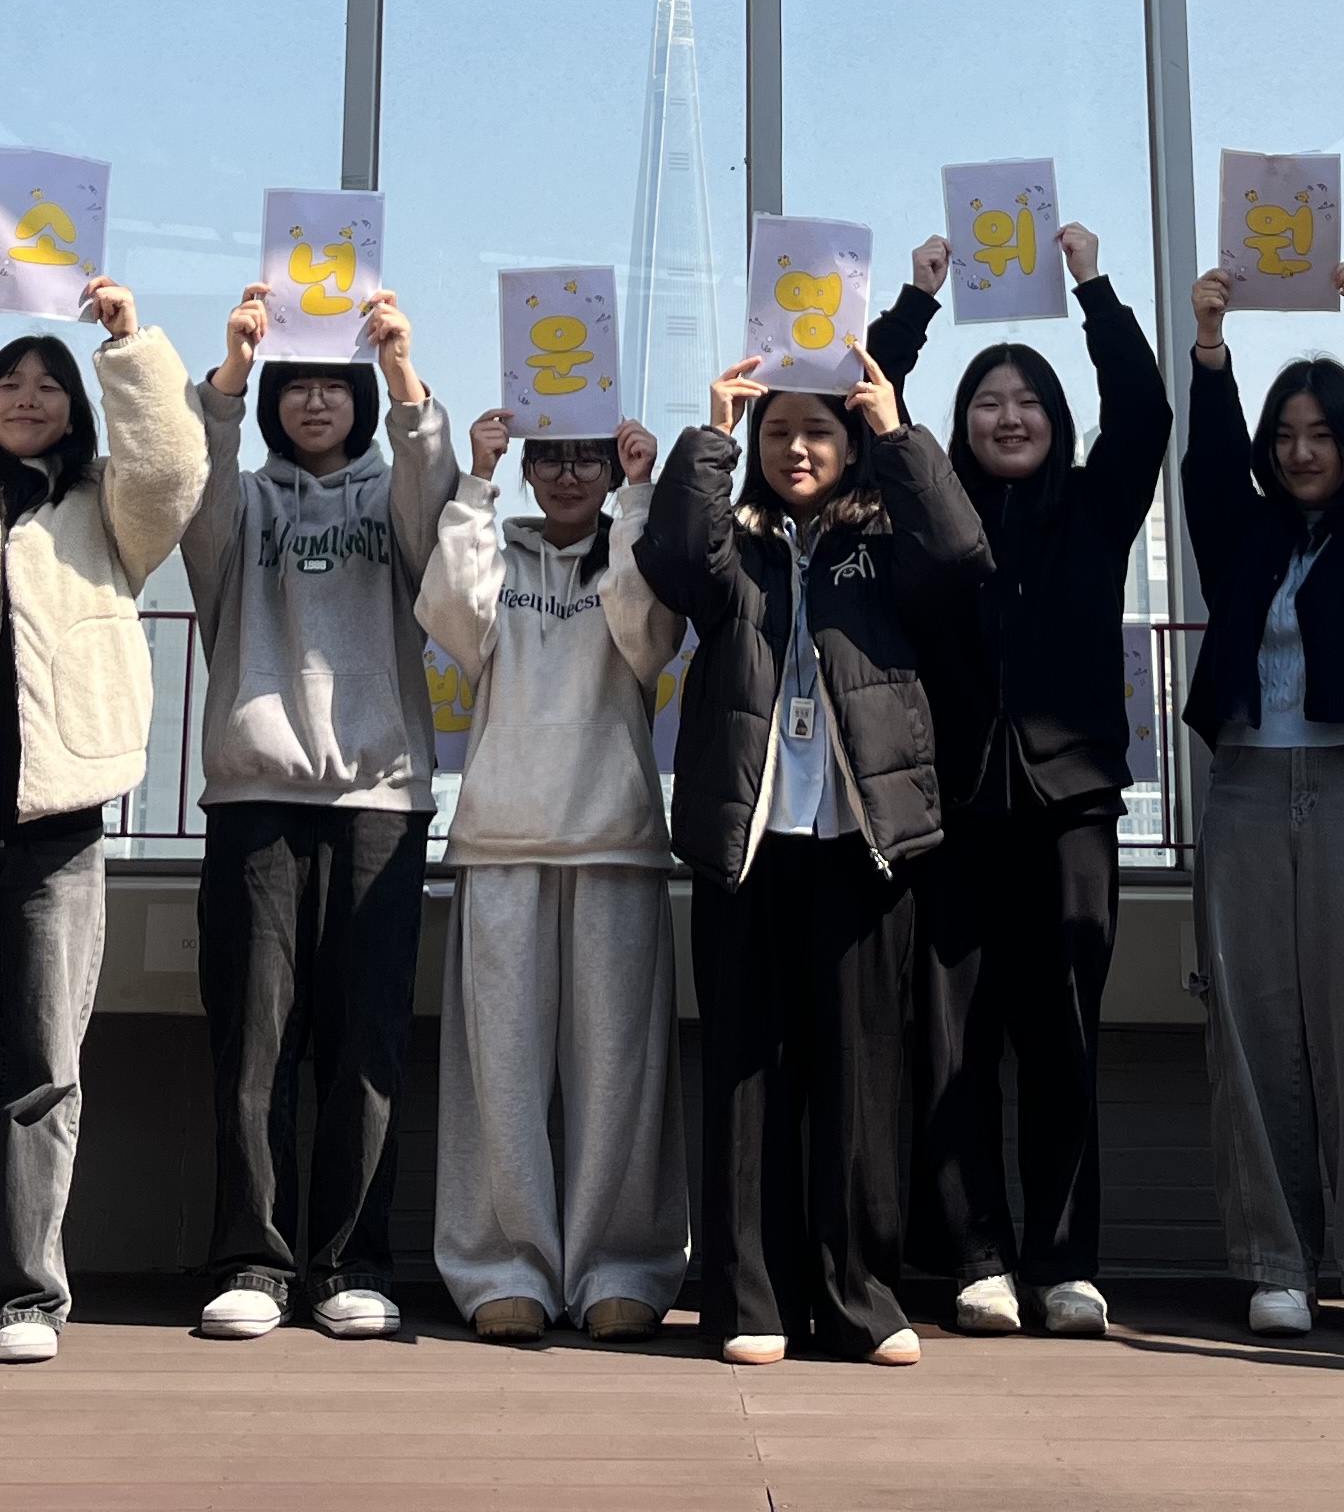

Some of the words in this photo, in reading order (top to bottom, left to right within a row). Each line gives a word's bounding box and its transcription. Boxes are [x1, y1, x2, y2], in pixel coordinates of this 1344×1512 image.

[8, 201, 80, 266] 소
[973, 207, 1035, 276] 위
[1243, 204, 1313, 276] 원
[288, 242, 357, 316] 년
[774, 271, 843, 350] 영
[525, 315, 594, 395] 운
